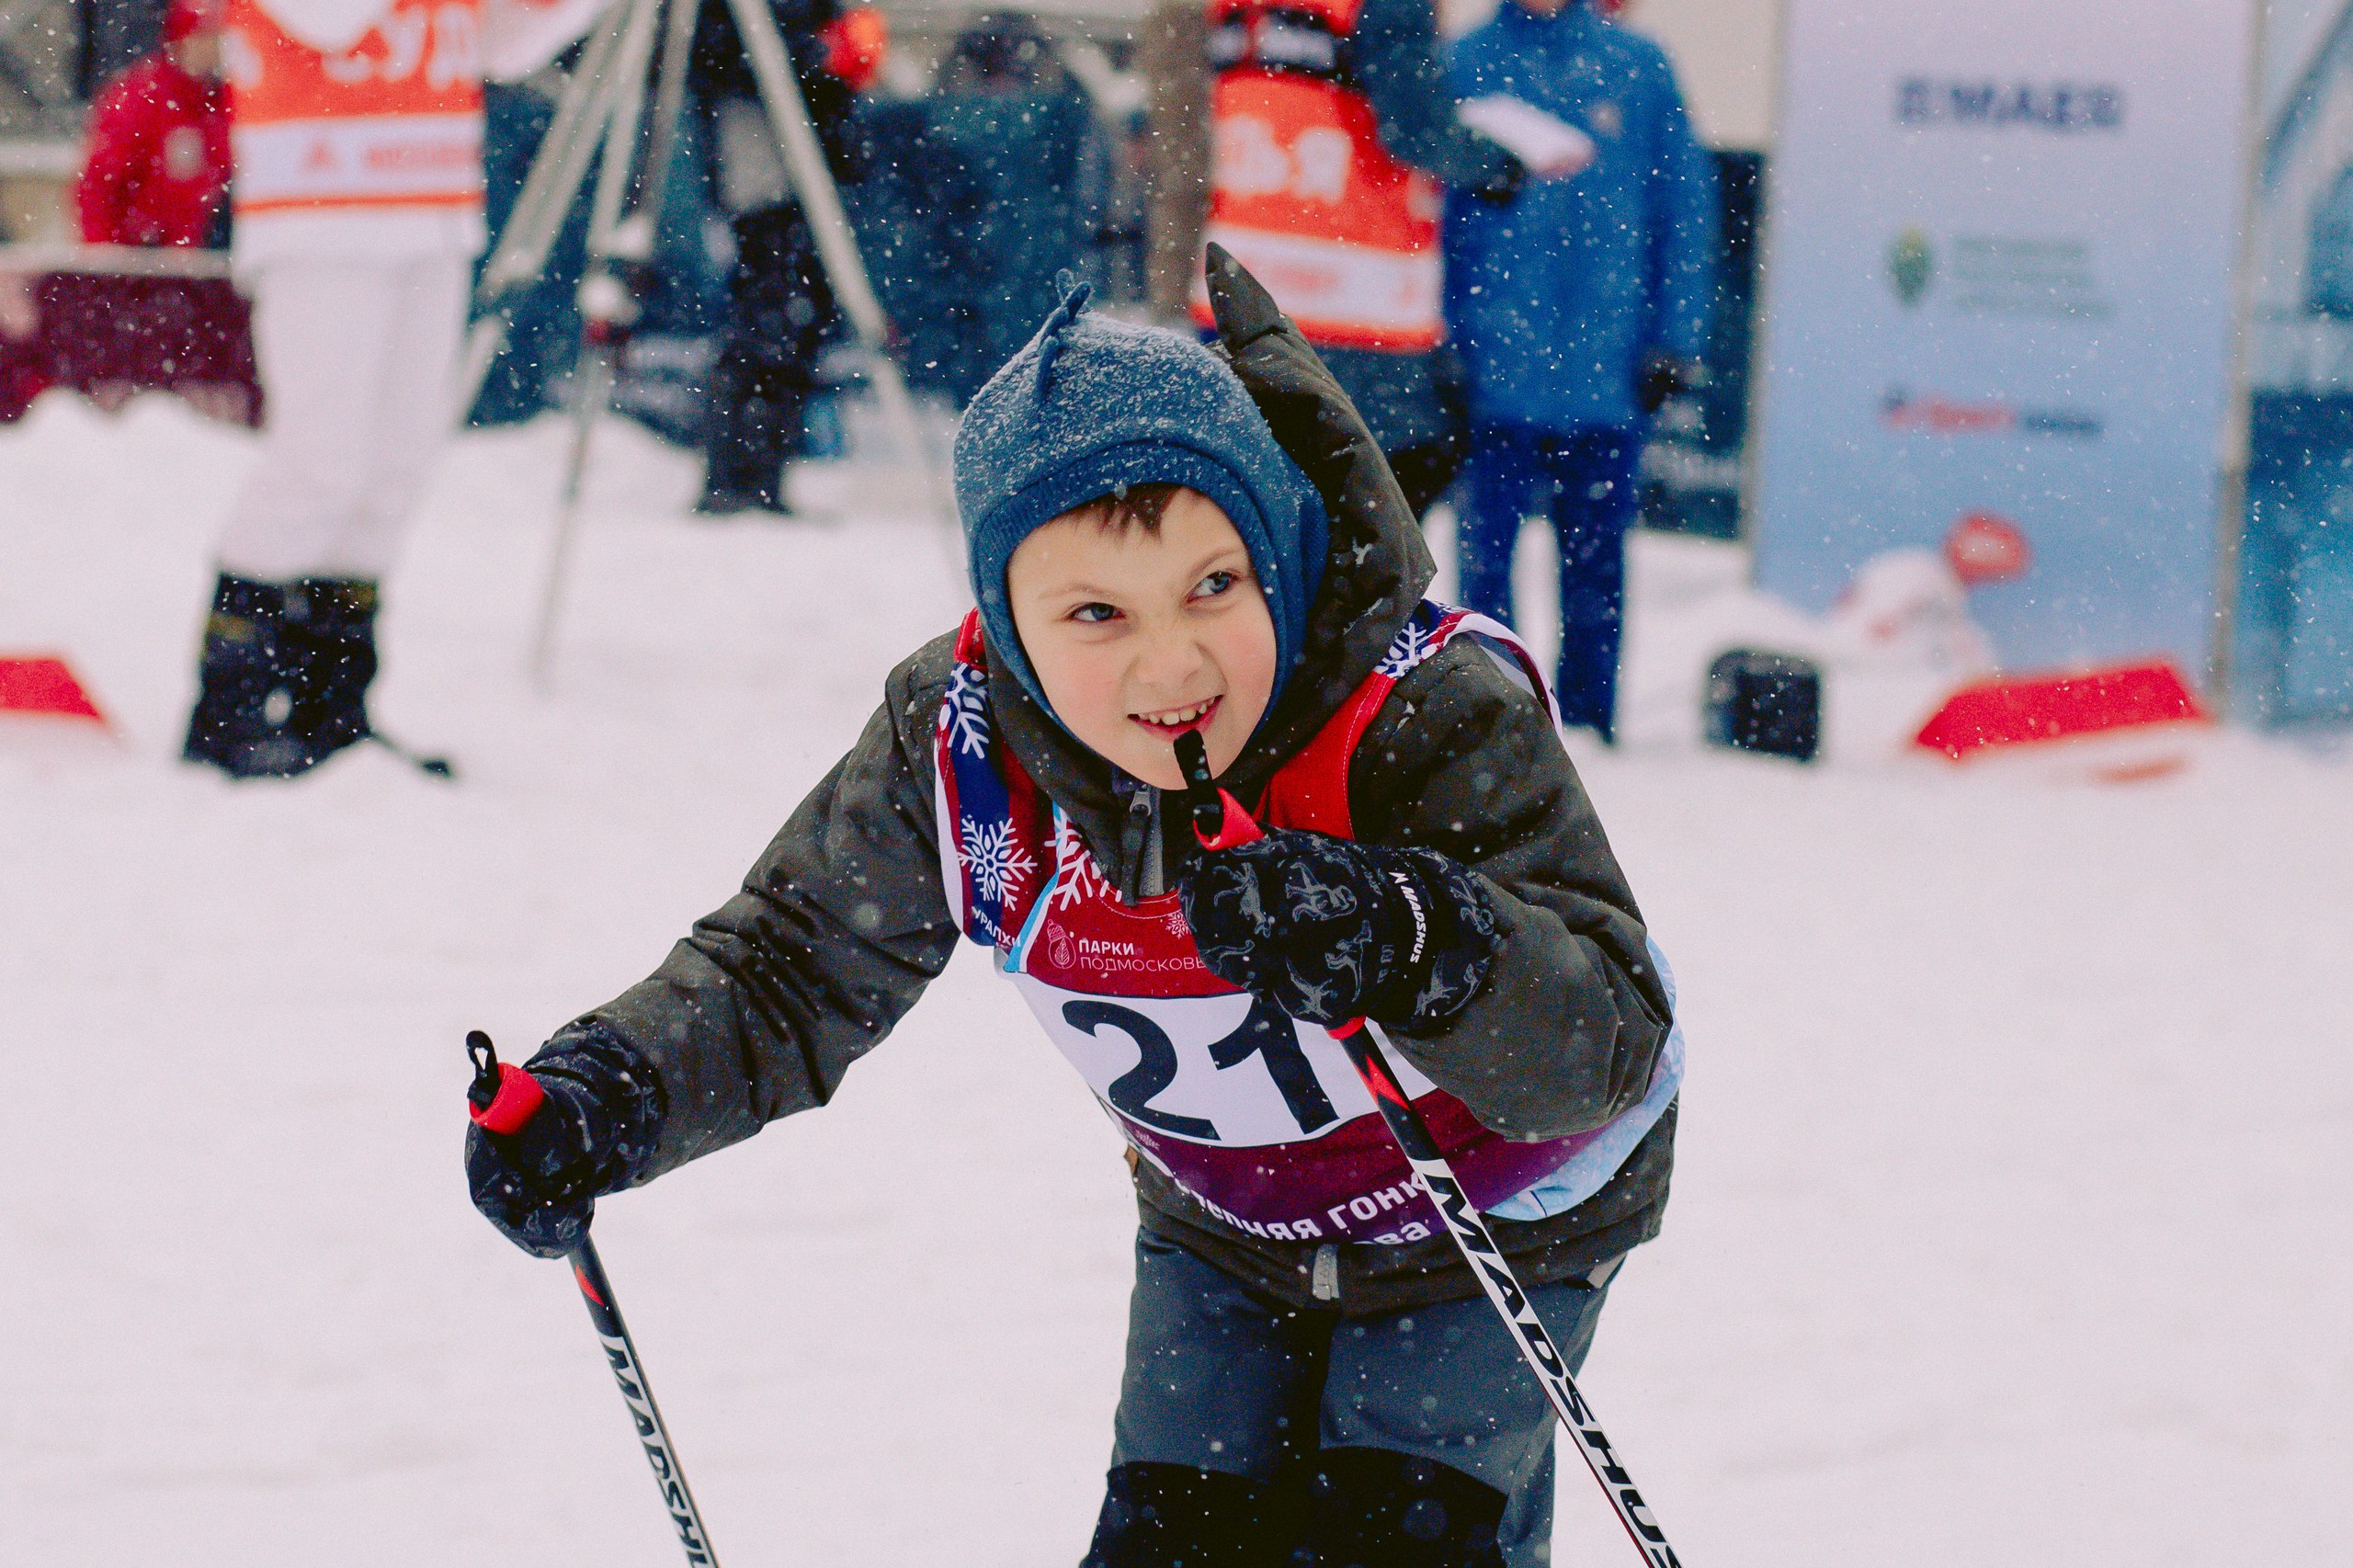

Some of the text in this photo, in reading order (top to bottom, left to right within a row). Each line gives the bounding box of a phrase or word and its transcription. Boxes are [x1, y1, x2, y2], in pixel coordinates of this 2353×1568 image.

[971, 905, 1021, 948] УРАЛХИ
[1400, 885, 1427, 964] MADSHUS
[1078, 939, 1135, 956] ПАРКИ
[1080, 956, 1206, 971] ПОДМОСКОВЬ
[1062, 991, 1340, 1141] 21
